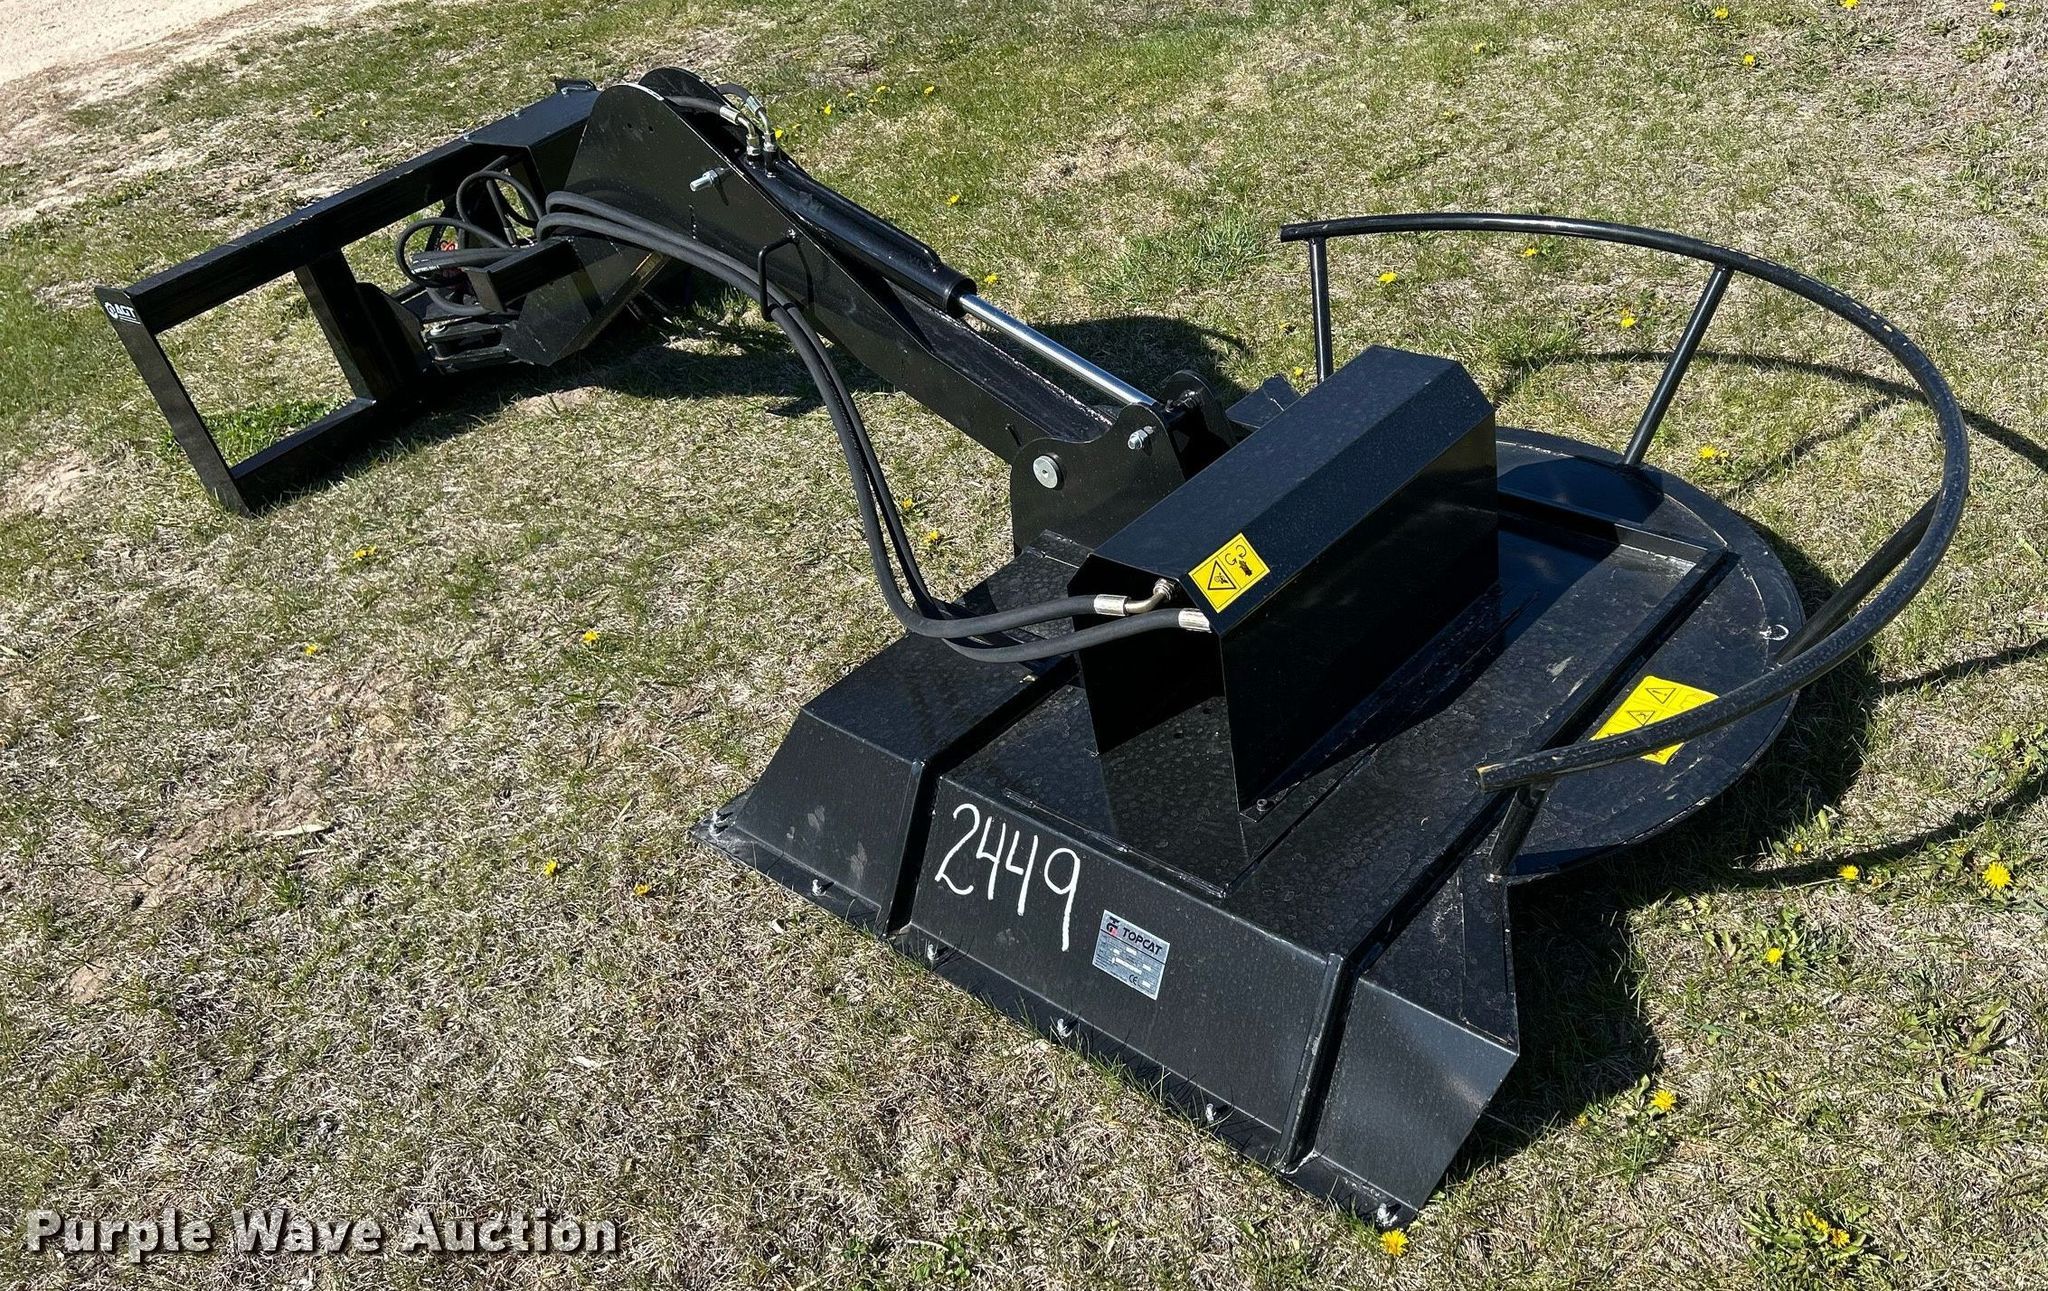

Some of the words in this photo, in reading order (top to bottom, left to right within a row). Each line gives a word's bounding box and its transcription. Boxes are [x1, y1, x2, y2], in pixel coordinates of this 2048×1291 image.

[114, 303, 136, 318] AGT
[934, 803, 1081, 951] 2449
[1122, 927, 1163, 955] TOPCAT
